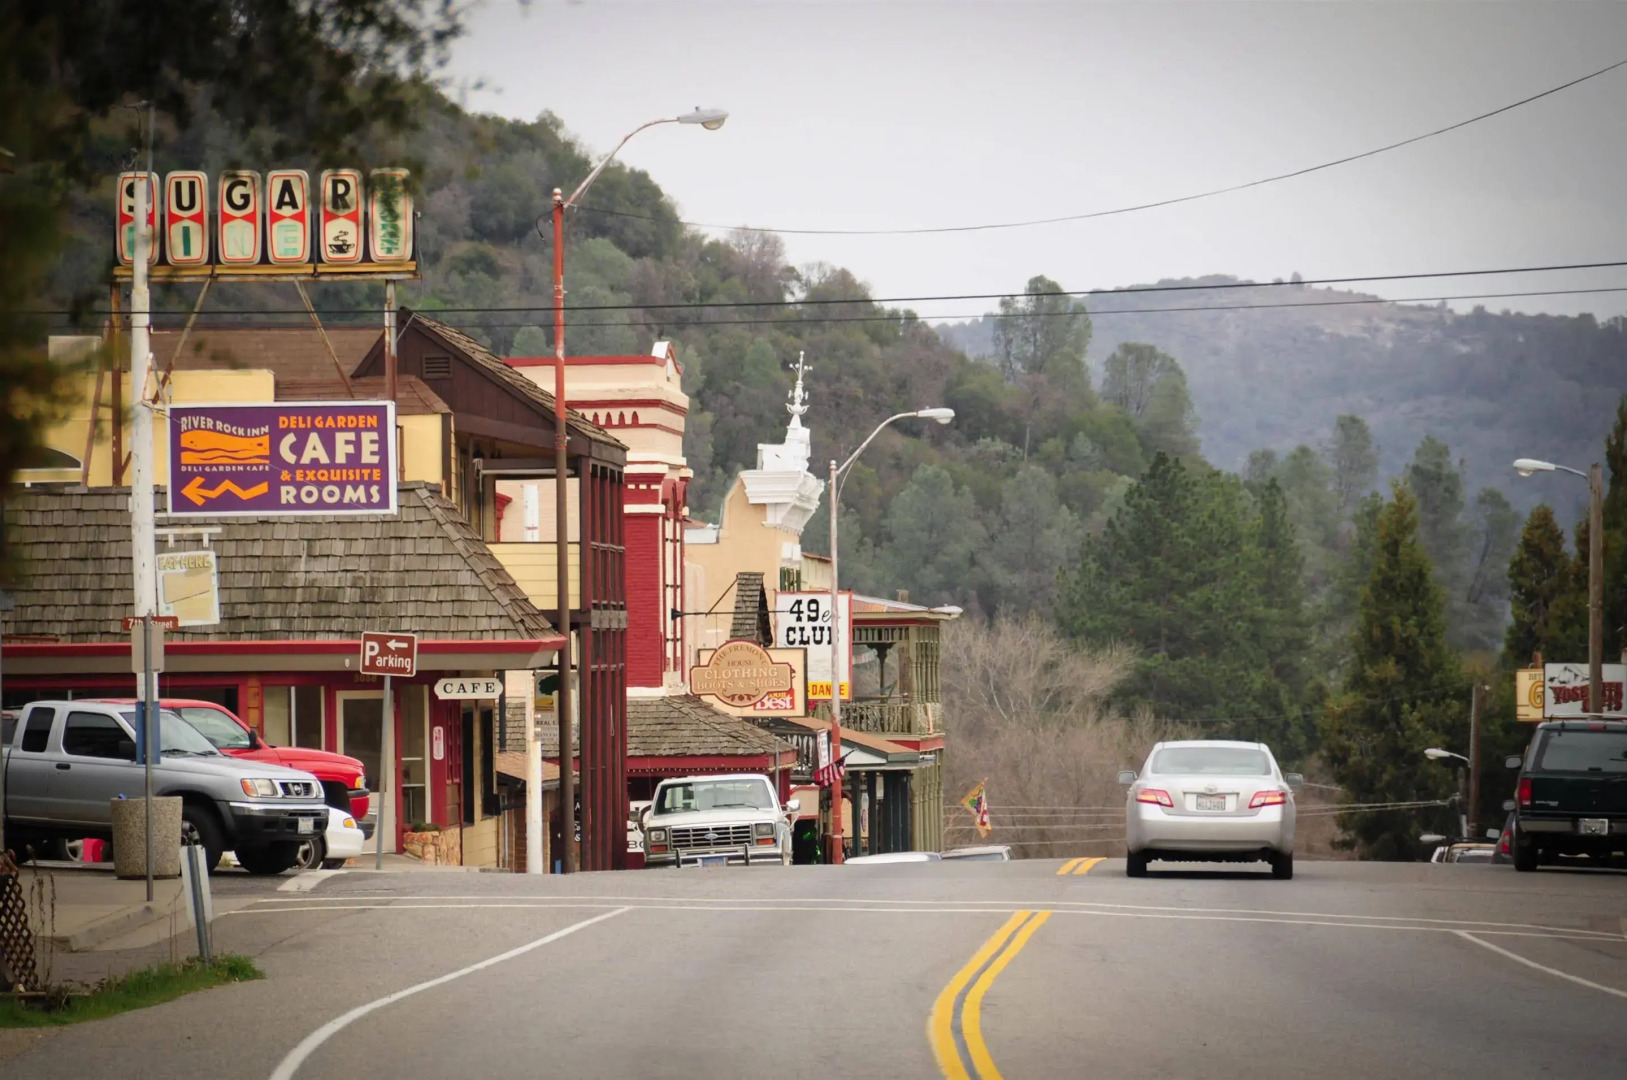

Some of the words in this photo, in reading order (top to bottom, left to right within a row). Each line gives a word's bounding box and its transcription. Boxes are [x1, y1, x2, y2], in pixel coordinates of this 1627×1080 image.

[181, 416, 213, 433] RIVER
[216, 420, 245, 437] ROCK
[247, 425, 269, 437] INN
[279, 415, 311, 429] DELI
[314, 415, 378, 429] GARDEN
[279, 431, 380, 465] CAFE
[281, 469, 292, 482] &
[296, 468, 381, 482] EXQUISITE
[280, 484, 380, 505] ROOMS
[158, 556, 177, 570] EAT
[180, 554, 211, 569] HERE
[365, 641, 412, 673] Parking
[704, 667, 778, 680] CLOTHING
[443, 682, 495, 694] CAFE
[697, 680, 734, 690] BOOTS
[749, 678, 786, 688] SHOES
[811, 684, 845, 696] DANE
